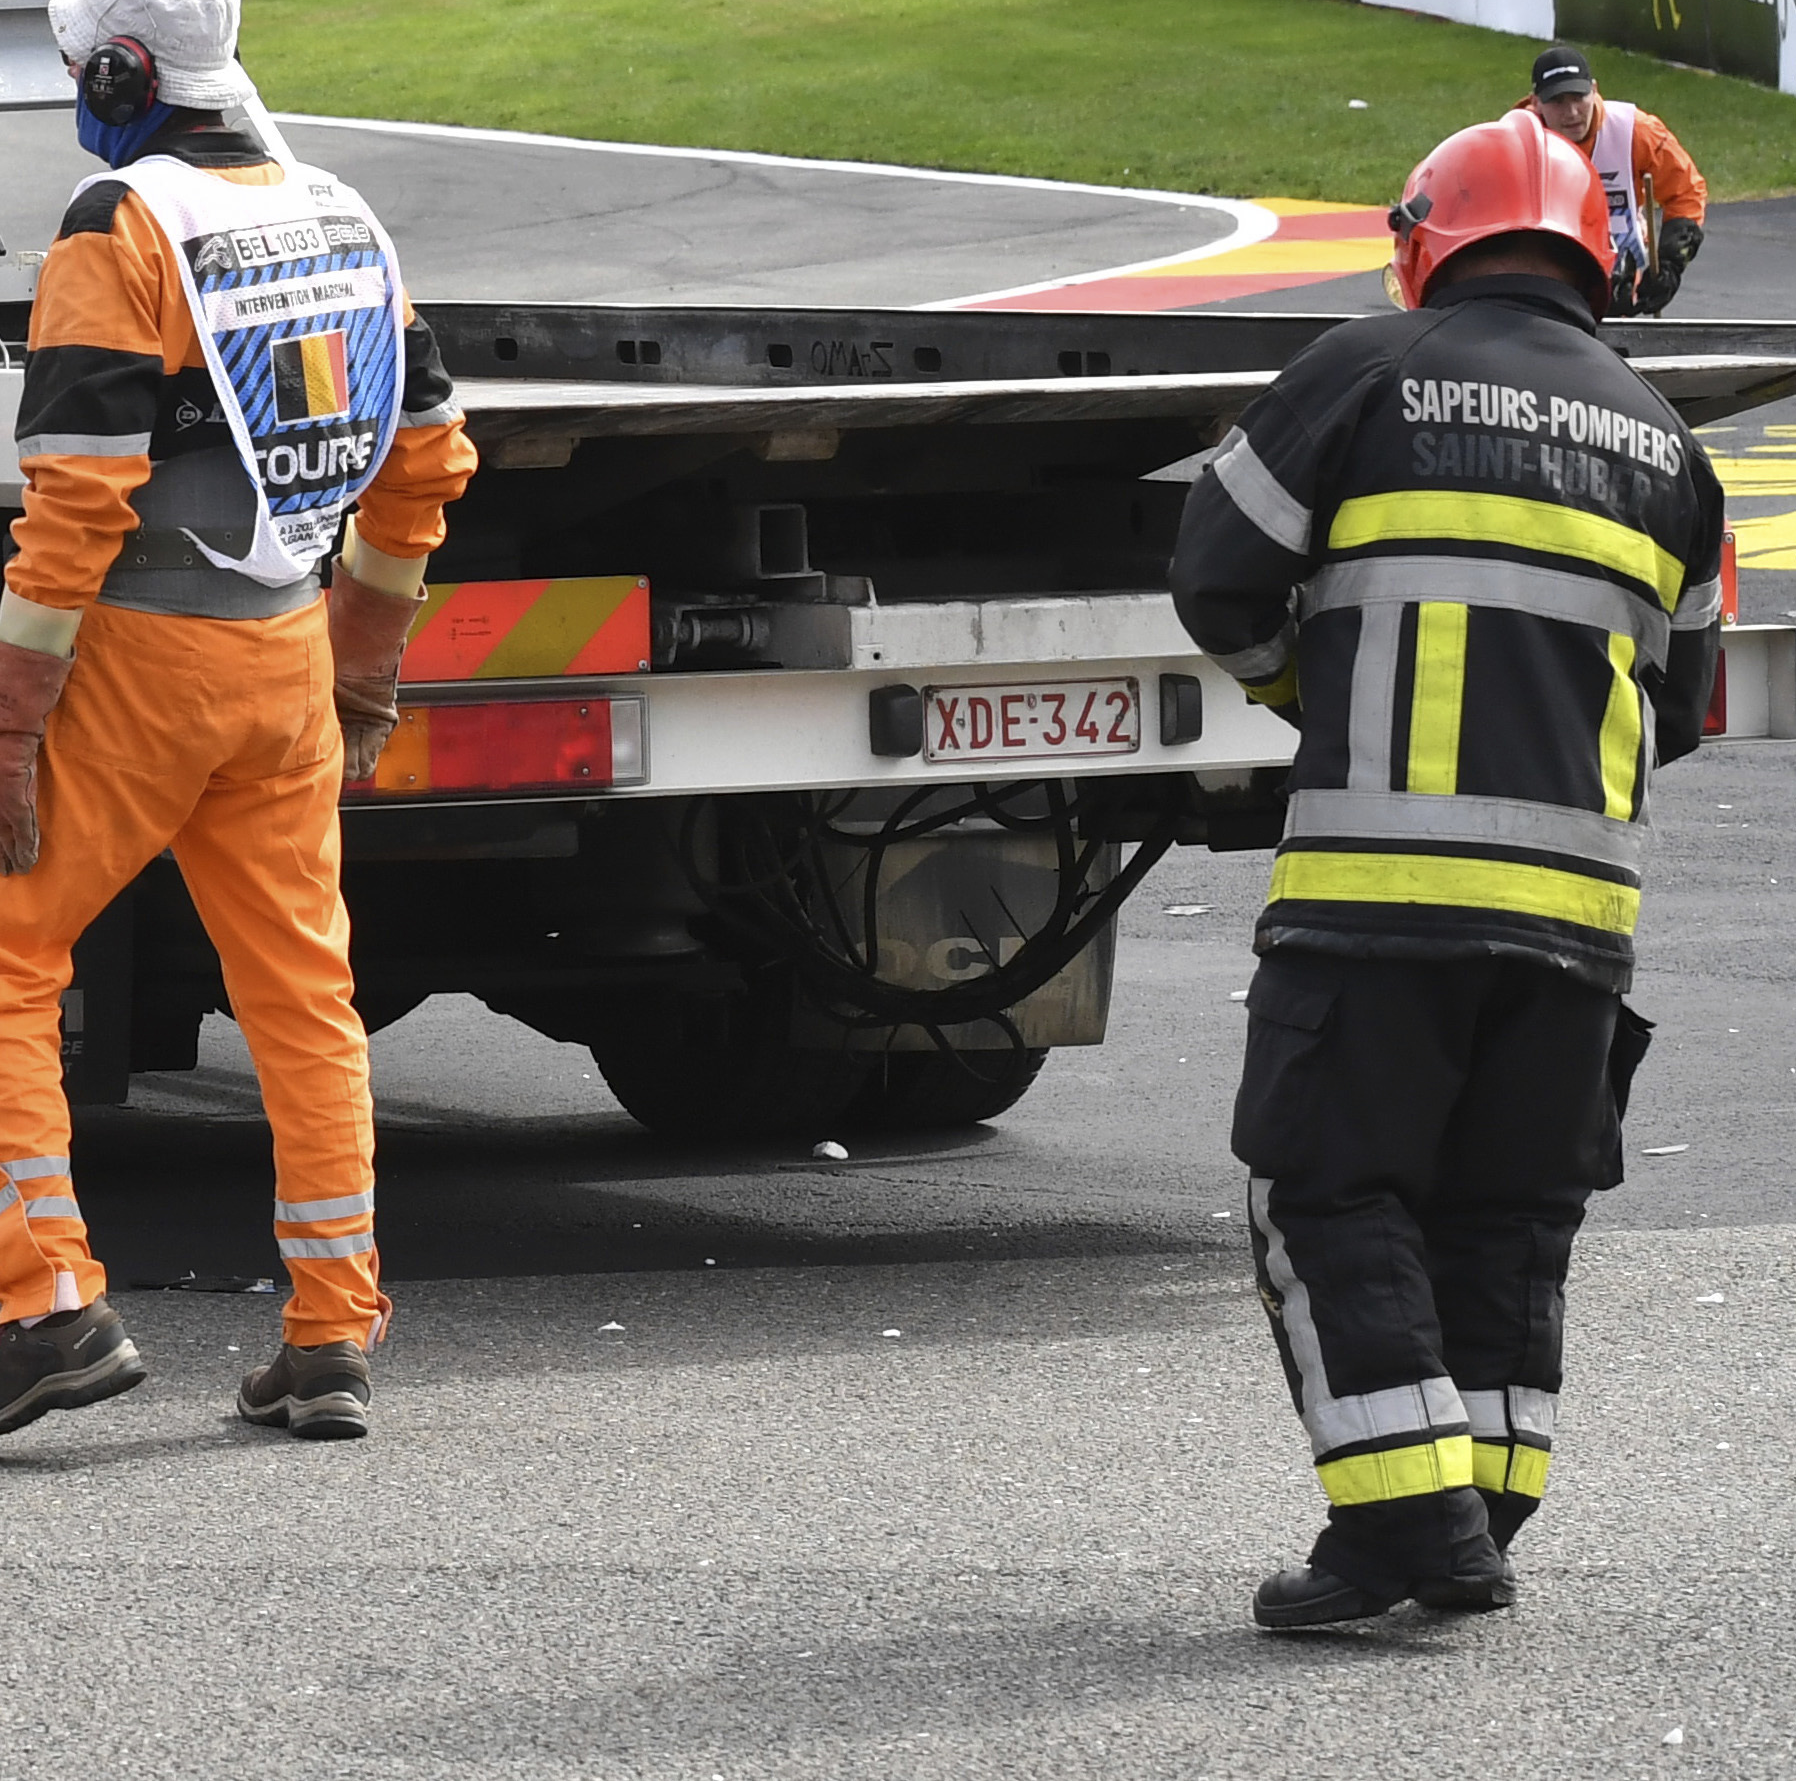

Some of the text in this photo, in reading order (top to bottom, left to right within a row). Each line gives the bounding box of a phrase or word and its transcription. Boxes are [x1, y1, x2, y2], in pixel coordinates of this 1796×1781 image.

[236, 228, 320, 262] BEL1033
[234, 281, 357, 317] INTERVENTION MARSHAL
[1401, 378, 1682, 477] SAPEURS-POMPIERS
[936, 690, 1132, 751] XDE-342
